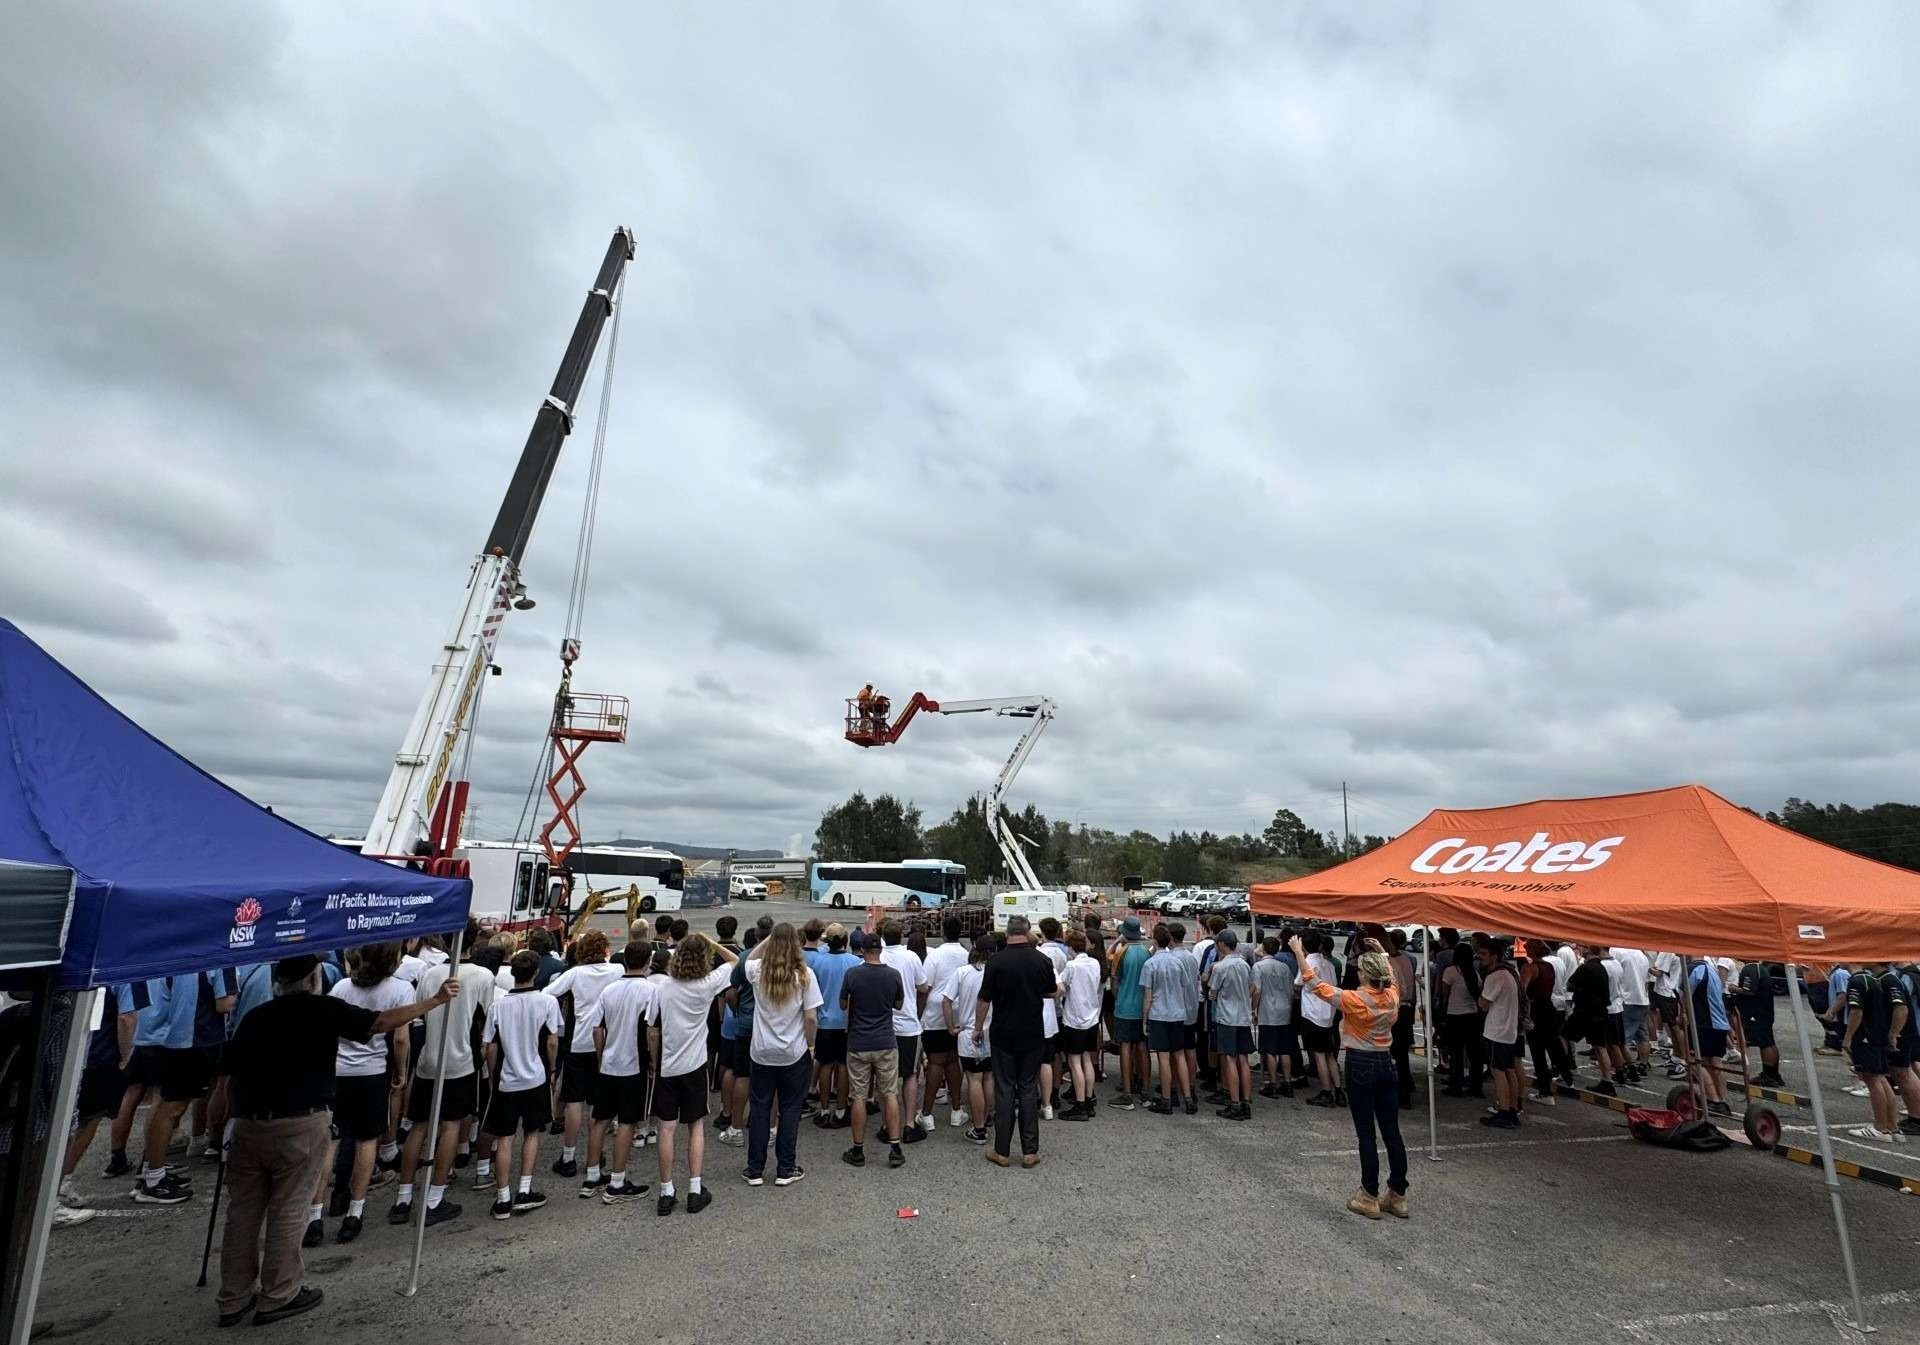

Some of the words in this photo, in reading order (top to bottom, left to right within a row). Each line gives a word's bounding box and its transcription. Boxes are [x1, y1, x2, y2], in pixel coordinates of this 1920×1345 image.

[1410, 832, 1625, 874] Coates
[1378, 877, 1459, 889] Equipped
[1484, 882, 1576, 892] anything
[325, 894, 339, 909] M1
[340, 893, 366, 908] Pacific
[367, 893, 400, 908] Motorway
[401, 893, 433, 906] extension
[347, 916, 356, 930] to
[357, 912, 392, 930] Raymond
[392, 912, 416, 925] Terrace
[229, 925, 256, 943] NSW
